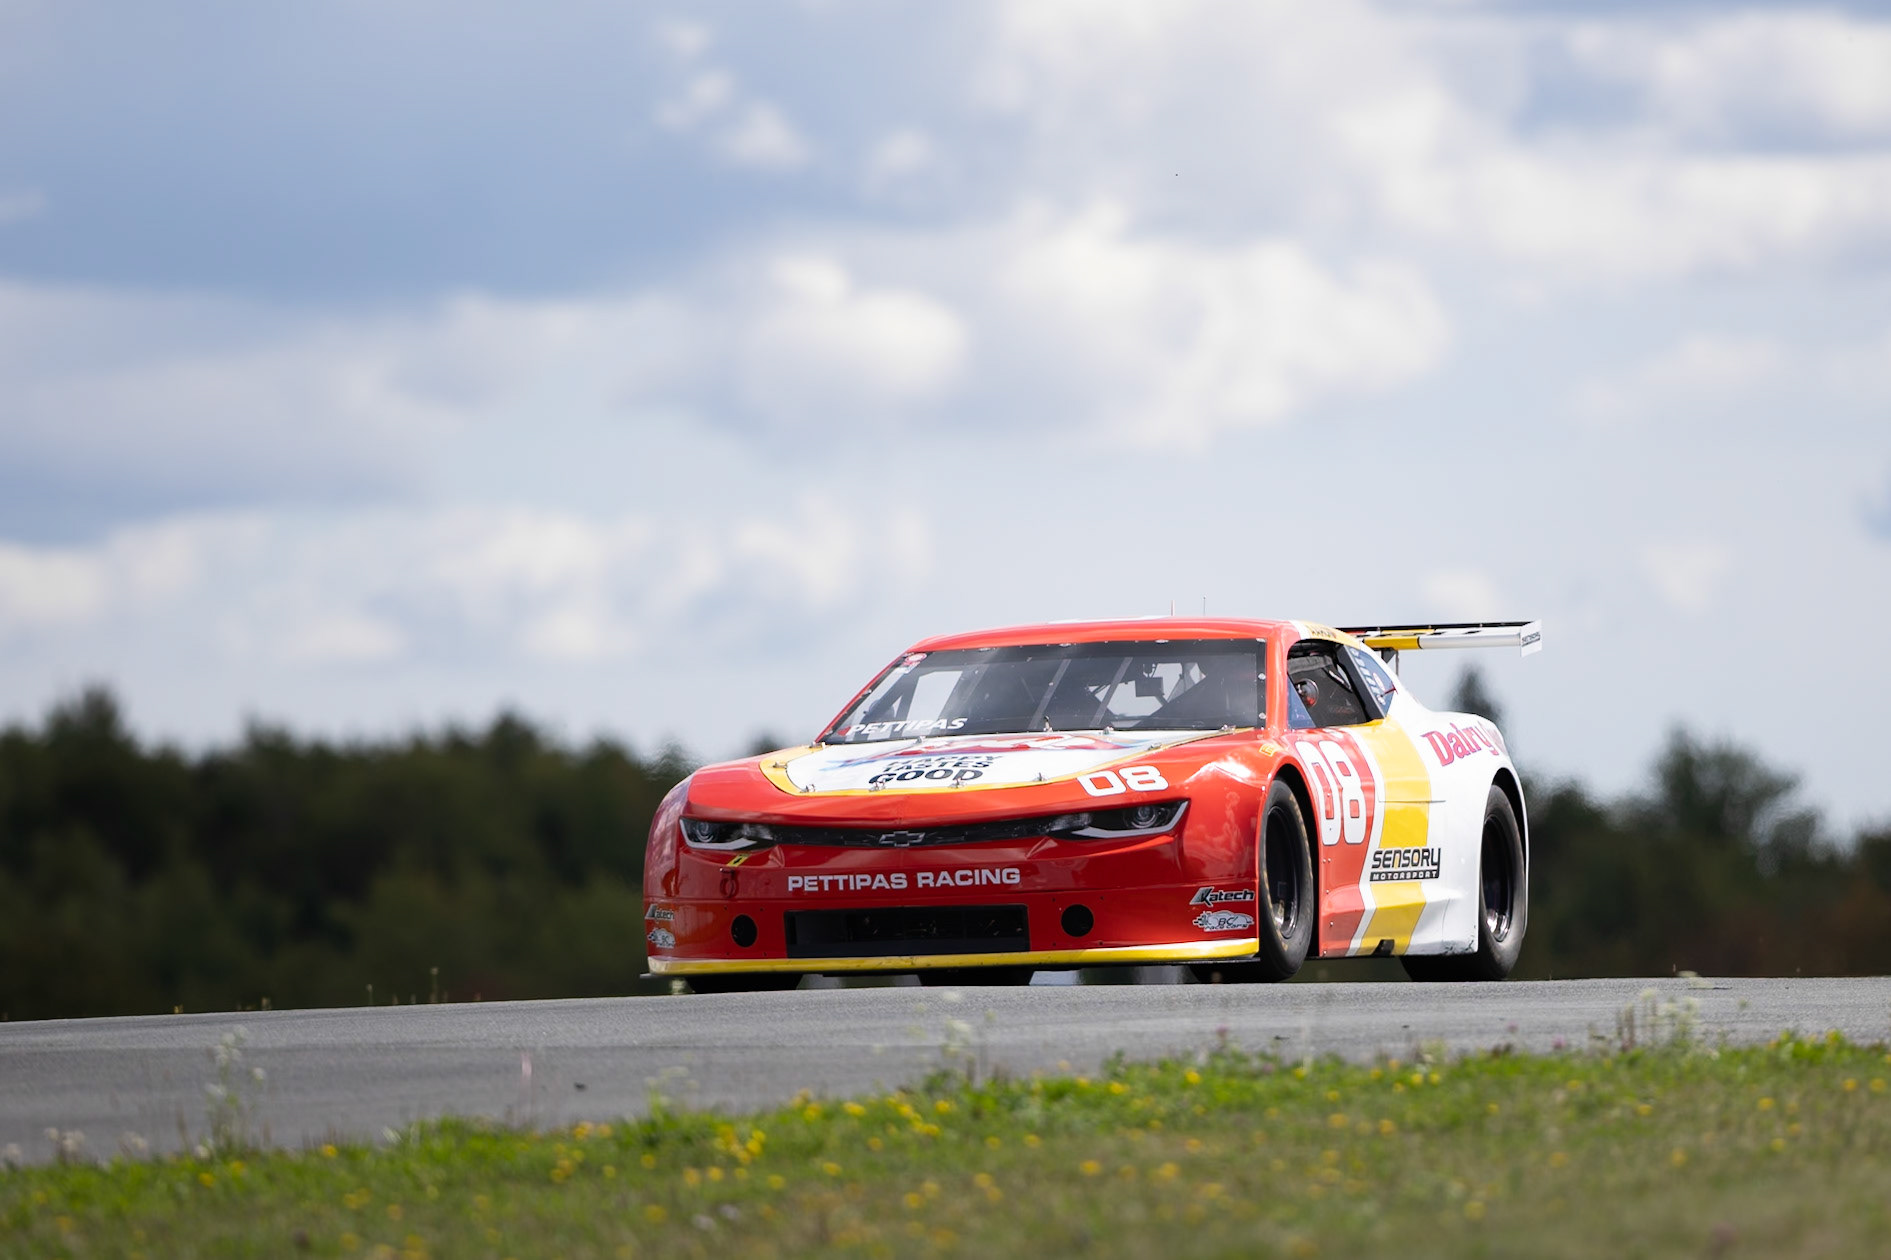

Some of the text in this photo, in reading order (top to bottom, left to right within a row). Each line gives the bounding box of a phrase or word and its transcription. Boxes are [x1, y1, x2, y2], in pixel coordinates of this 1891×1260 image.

[846, 717, 968, 736] PETTIPAS
[1420, 721, 1499, 767] Dairy
[869, 768, 984, 785] GOOD
[883, 761, 994, 773] TASTES
[1077, 764, 1169, 798] 08
[1294, 739, 1367, 847] 08
[1371, 847, 1441, 873] SENSORY
[787, 867, 1021, 893] PETTIPAS RACING
[1372, 870, 1438, 881] MOTORSPORT
[1193, 886, 1254, 906] Katech
